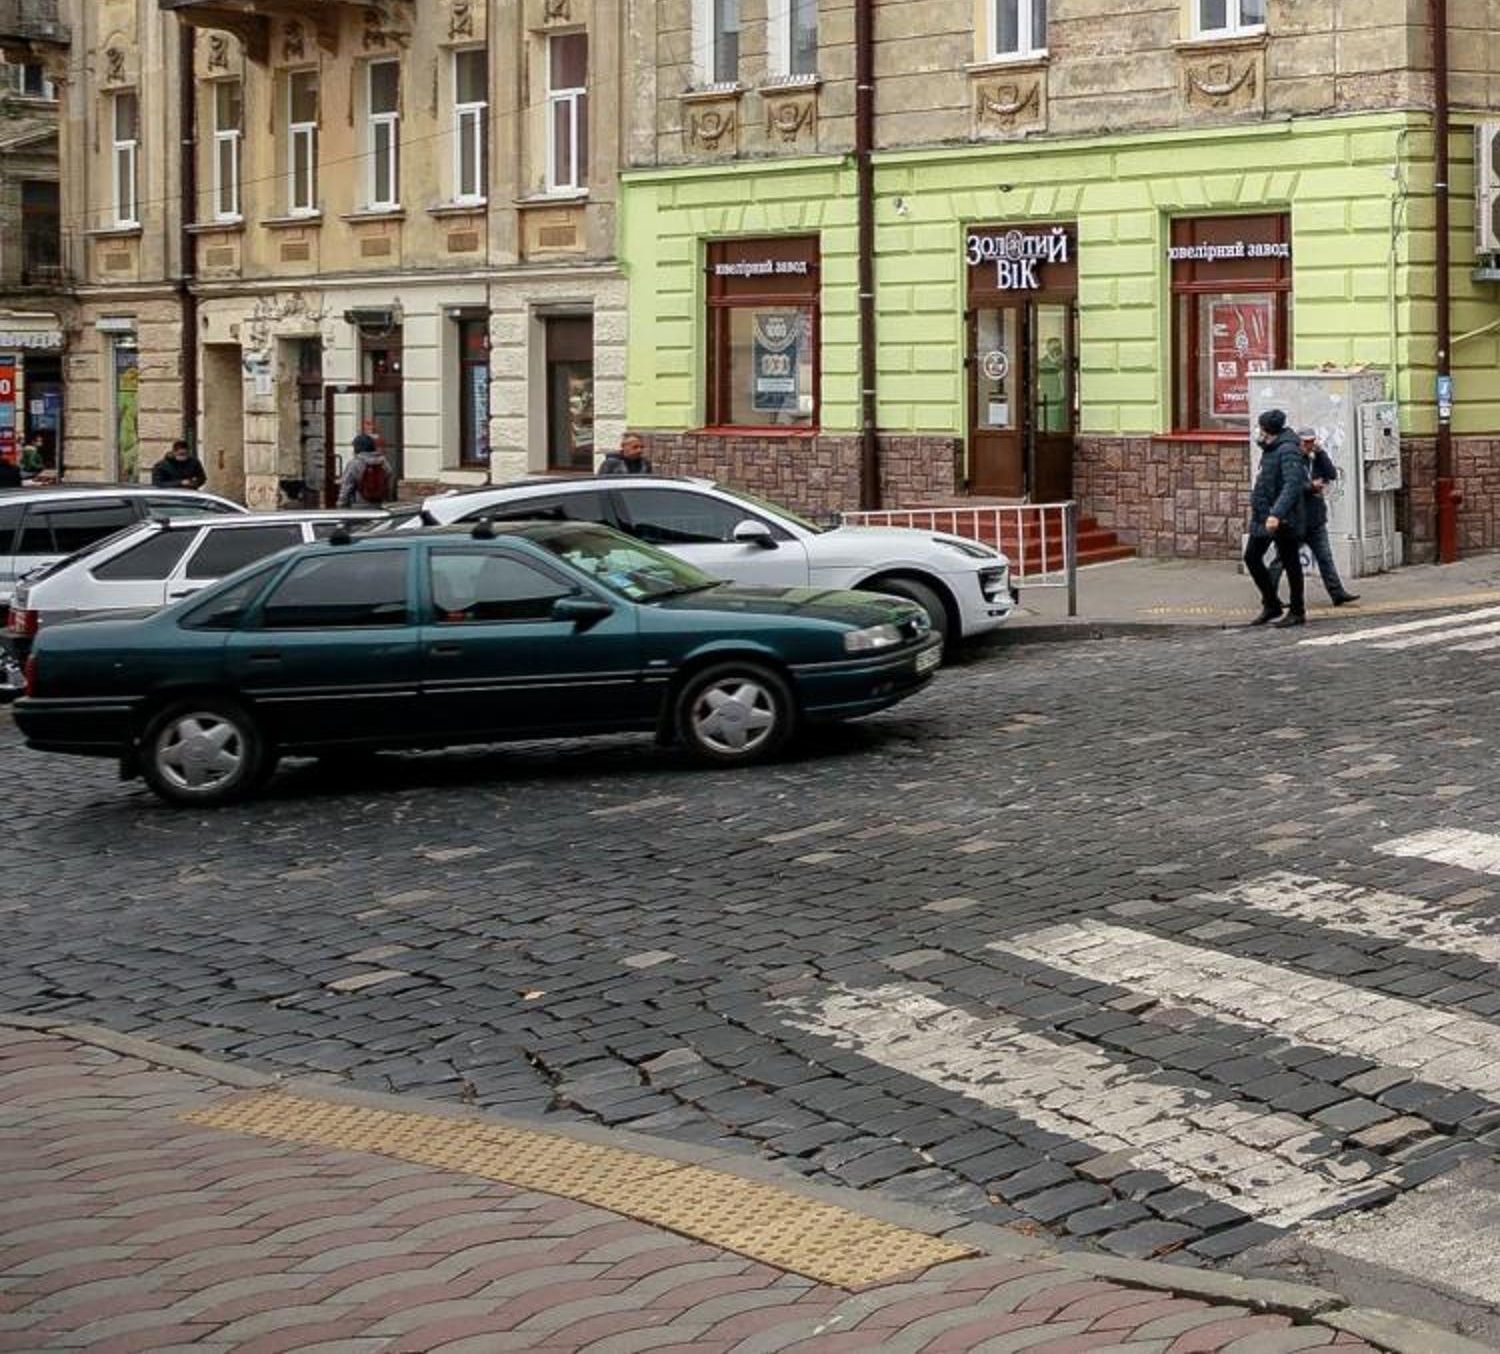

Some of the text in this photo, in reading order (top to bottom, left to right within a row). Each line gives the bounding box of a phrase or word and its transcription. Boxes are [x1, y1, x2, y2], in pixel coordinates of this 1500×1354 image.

[1169, 241, 1290, 262] ювелірний завод
[715, 259, 808, 277] ювелірний завод
